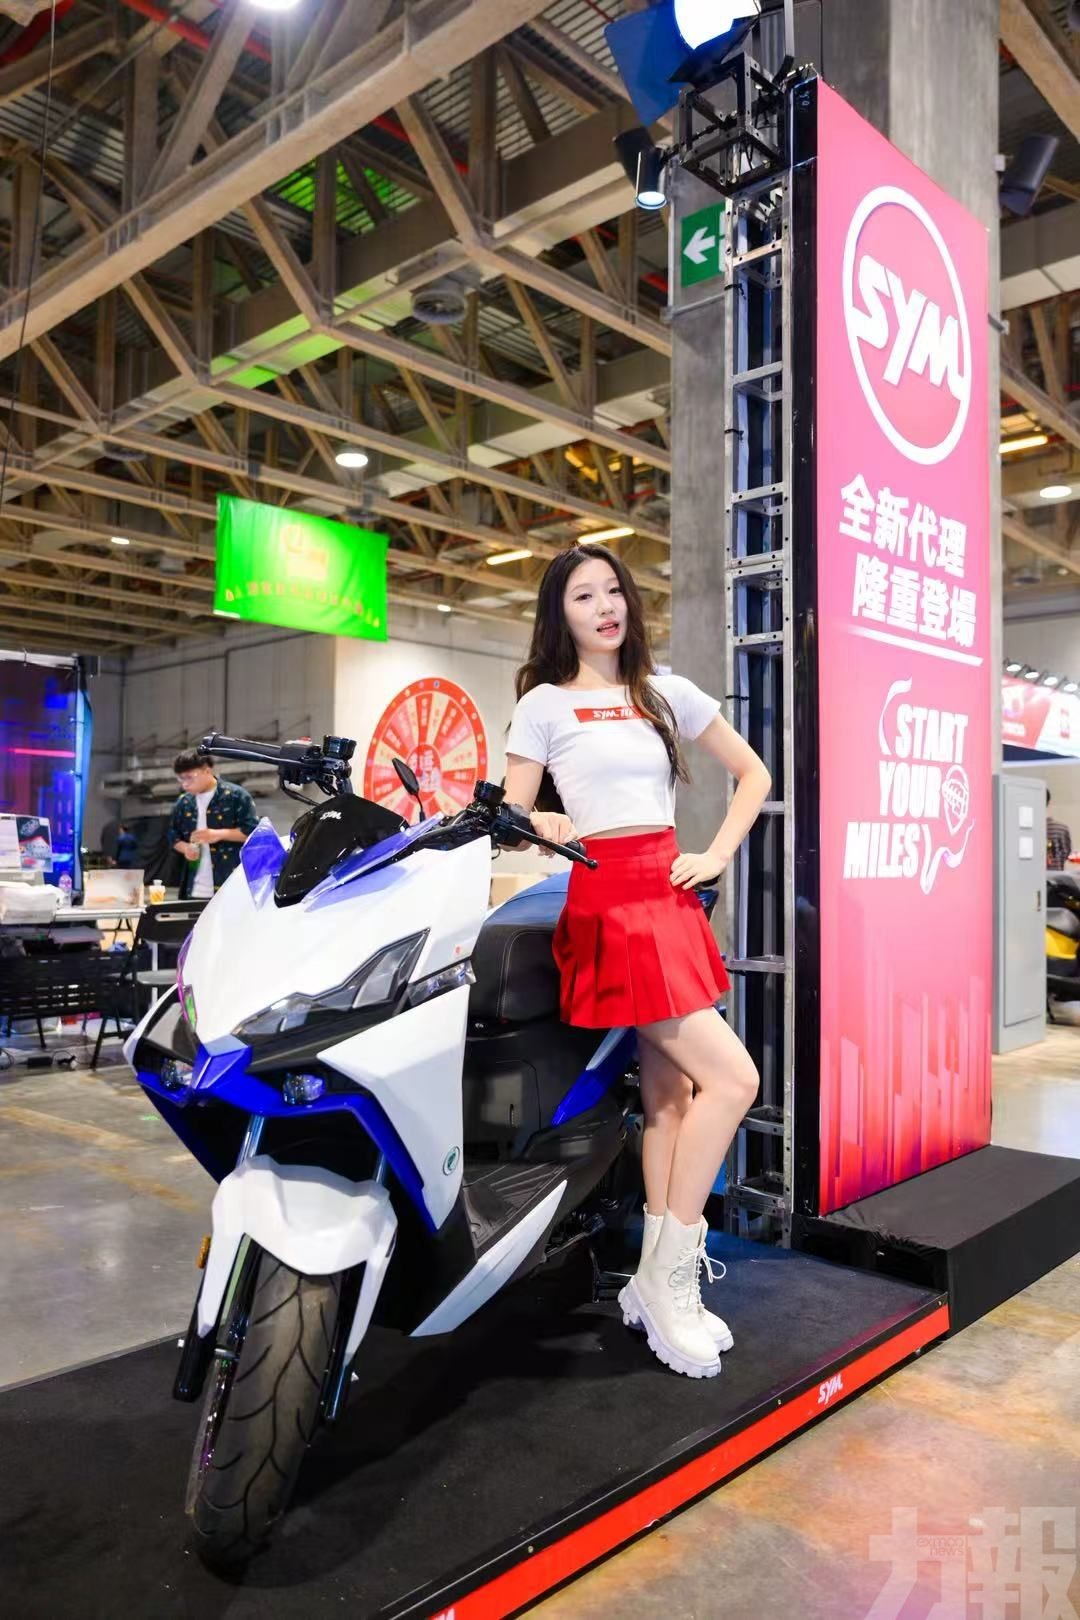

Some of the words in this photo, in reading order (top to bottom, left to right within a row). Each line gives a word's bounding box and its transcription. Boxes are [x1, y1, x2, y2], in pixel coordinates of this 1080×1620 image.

[851, 254, 964, 400] SYM
[838, 473, 967, 579] 全新代理
[852, 552, 976, 648] 隆重登場
[895, 703, 969, 764] START
[879, 760, 943, 819] YOUR
[843, 821, 921, 880] MILES
[817, 1371, 843, 1405] SYM
